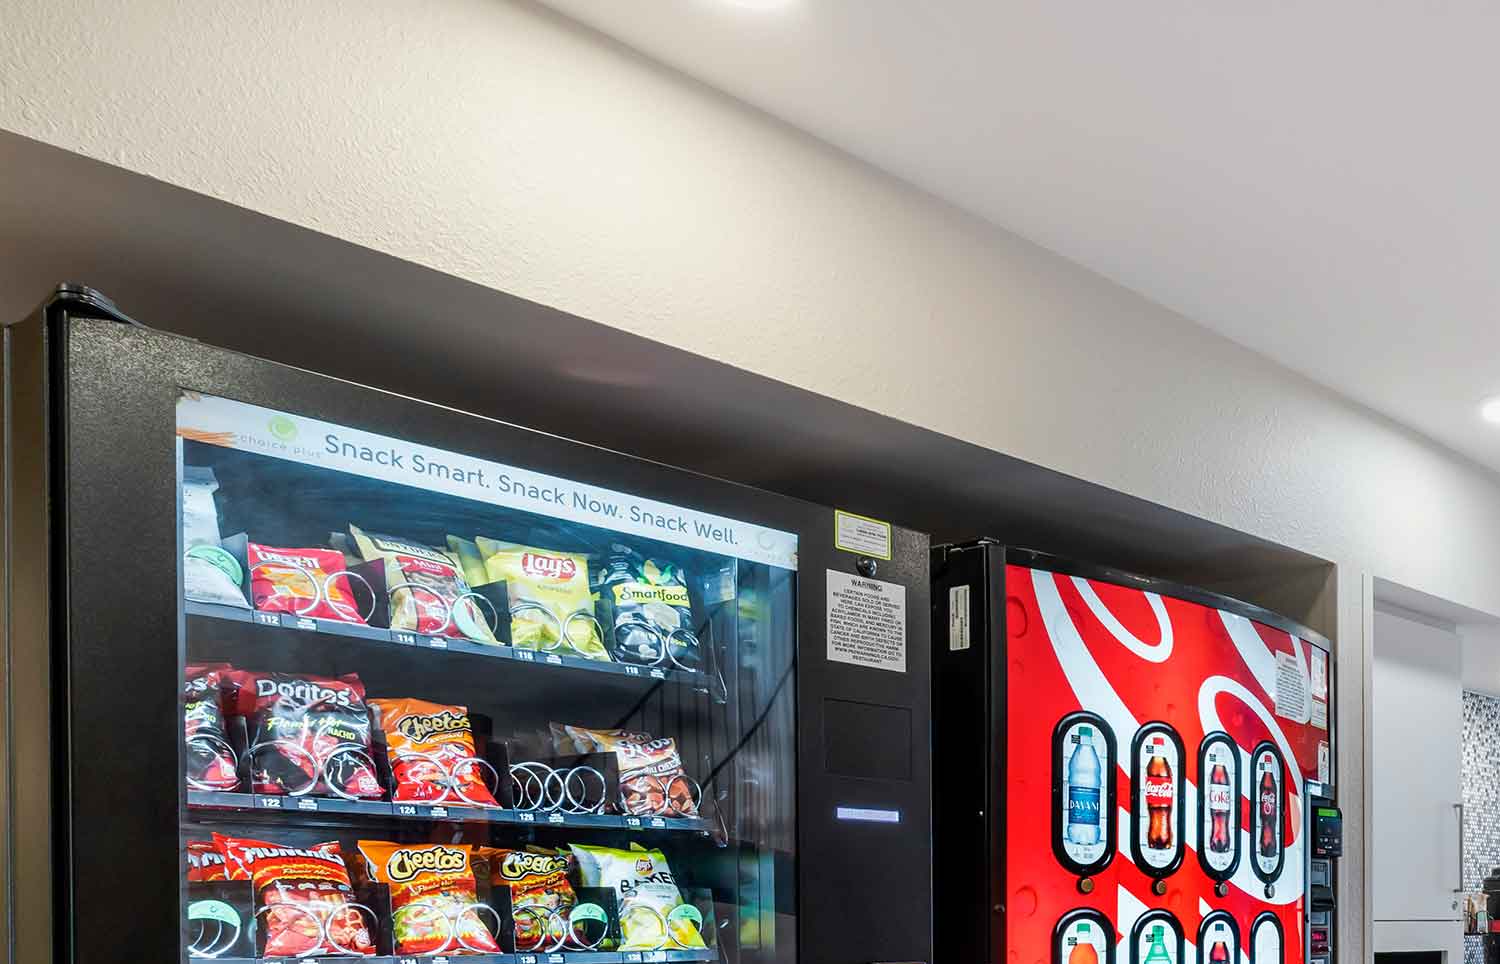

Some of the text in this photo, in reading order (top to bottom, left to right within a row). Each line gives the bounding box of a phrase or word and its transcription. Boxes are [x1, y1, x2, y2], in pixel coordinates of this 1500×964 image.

[325, 434, 738, 545] Snack Smart. Snack Now. Snack Well.
[850, 578, 882, 592] WARNING
[259, 614, 279, 625] 112
[256, 679, 351, 706] Doritos
[400, 712, 471, 740] Cheetos
[261, 798, 280, 808] 122
[399, 805, 416, 815] 124
[390, 847, 464, 879] Cheetos
